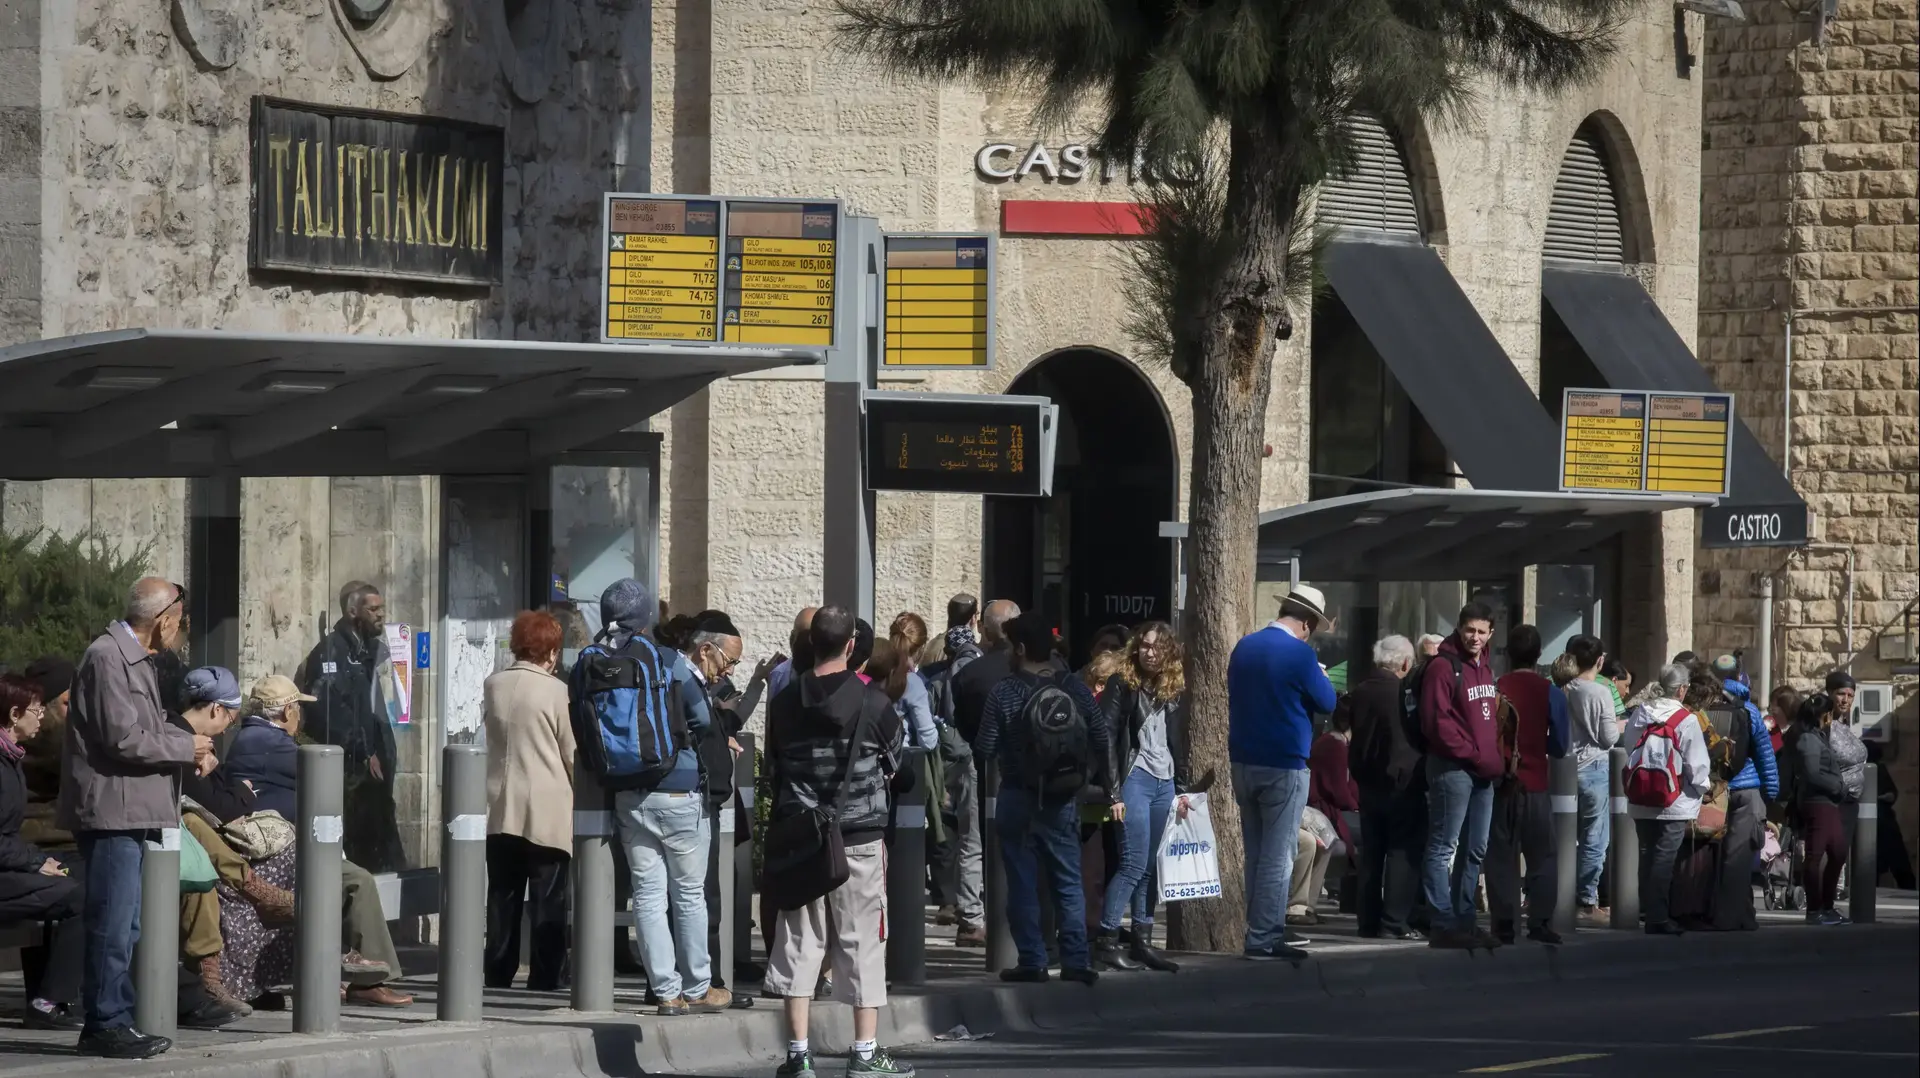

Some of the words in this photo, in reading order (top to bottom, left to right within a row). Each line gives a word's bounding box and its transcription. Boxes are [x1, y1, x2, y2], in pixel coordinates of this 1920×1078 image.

[629, 214, 654, 222] YEHUDA
[709, 240, 714, 250] 7
[818, 243, 832, 253] 102
[800, 259, 832, 271] 105,108
[693, 273, 715, 285] 71,72
[816, 279, 831, 288] 106
[689, 290, 714, 303] 74,75
[816, 296, 831, 306] 107
[700, 310, 711, 320] 78
[812, 315, 828, 324] 267
[1010, 425, 1023, 437] 71
[1010, 437, 1023, 448] 18
[1010, 460, 1023, 472] 34
[1728, 513, 1781, 540] CASTRO
[1104, 594, 1156, 618] קסטרו
[1467, 684, 1496, 702] HARVAR
[1164, 884, 1220, 898] 02-625-2980
